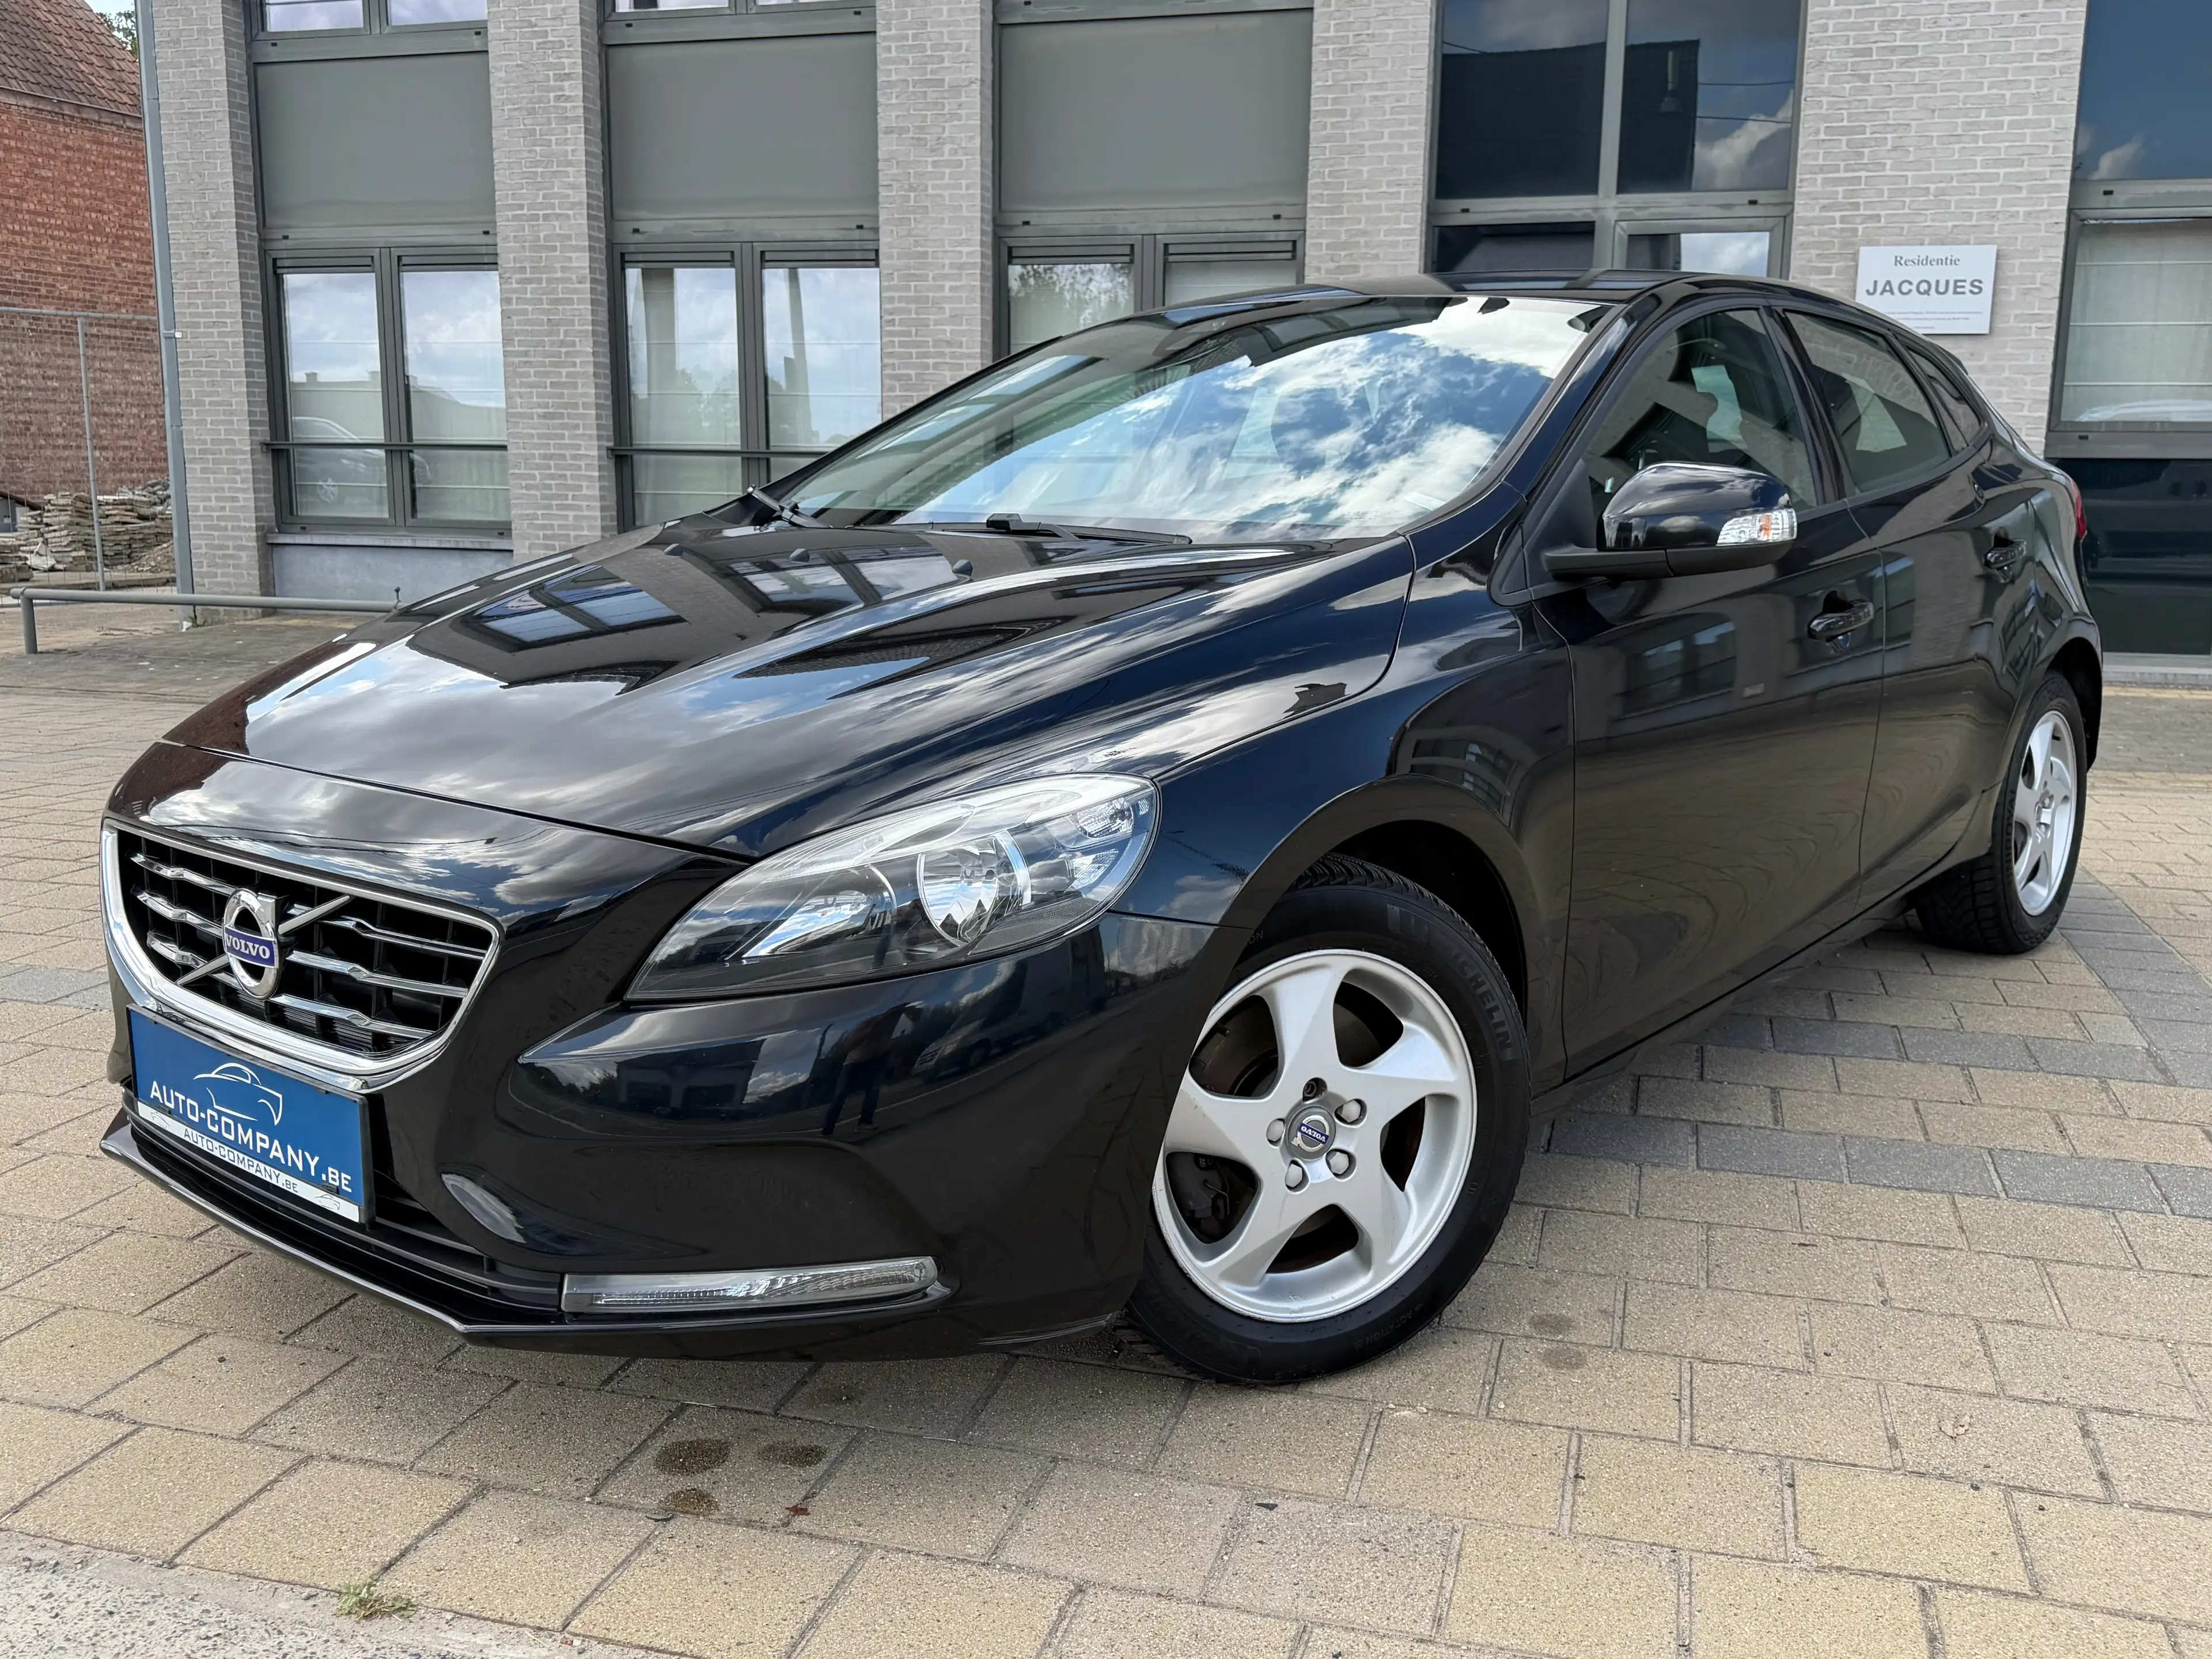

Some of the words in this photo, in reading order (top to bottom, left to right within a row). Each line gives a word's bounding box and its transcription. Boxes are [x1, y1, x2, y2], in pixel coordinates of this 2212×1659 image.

[1893, 255, 1960, 267] Residentie
[1865, 279, 1984, 297] JACQUES
[225, 933, 271, 960] VOLVO
[150, 1081, 353, 1193] AUTO-COMPANY.BE
[1301, 1126, 1326, 1142] VOLVO
[183, 1127, 298, 1194] AUTO-COMPANY.BE
